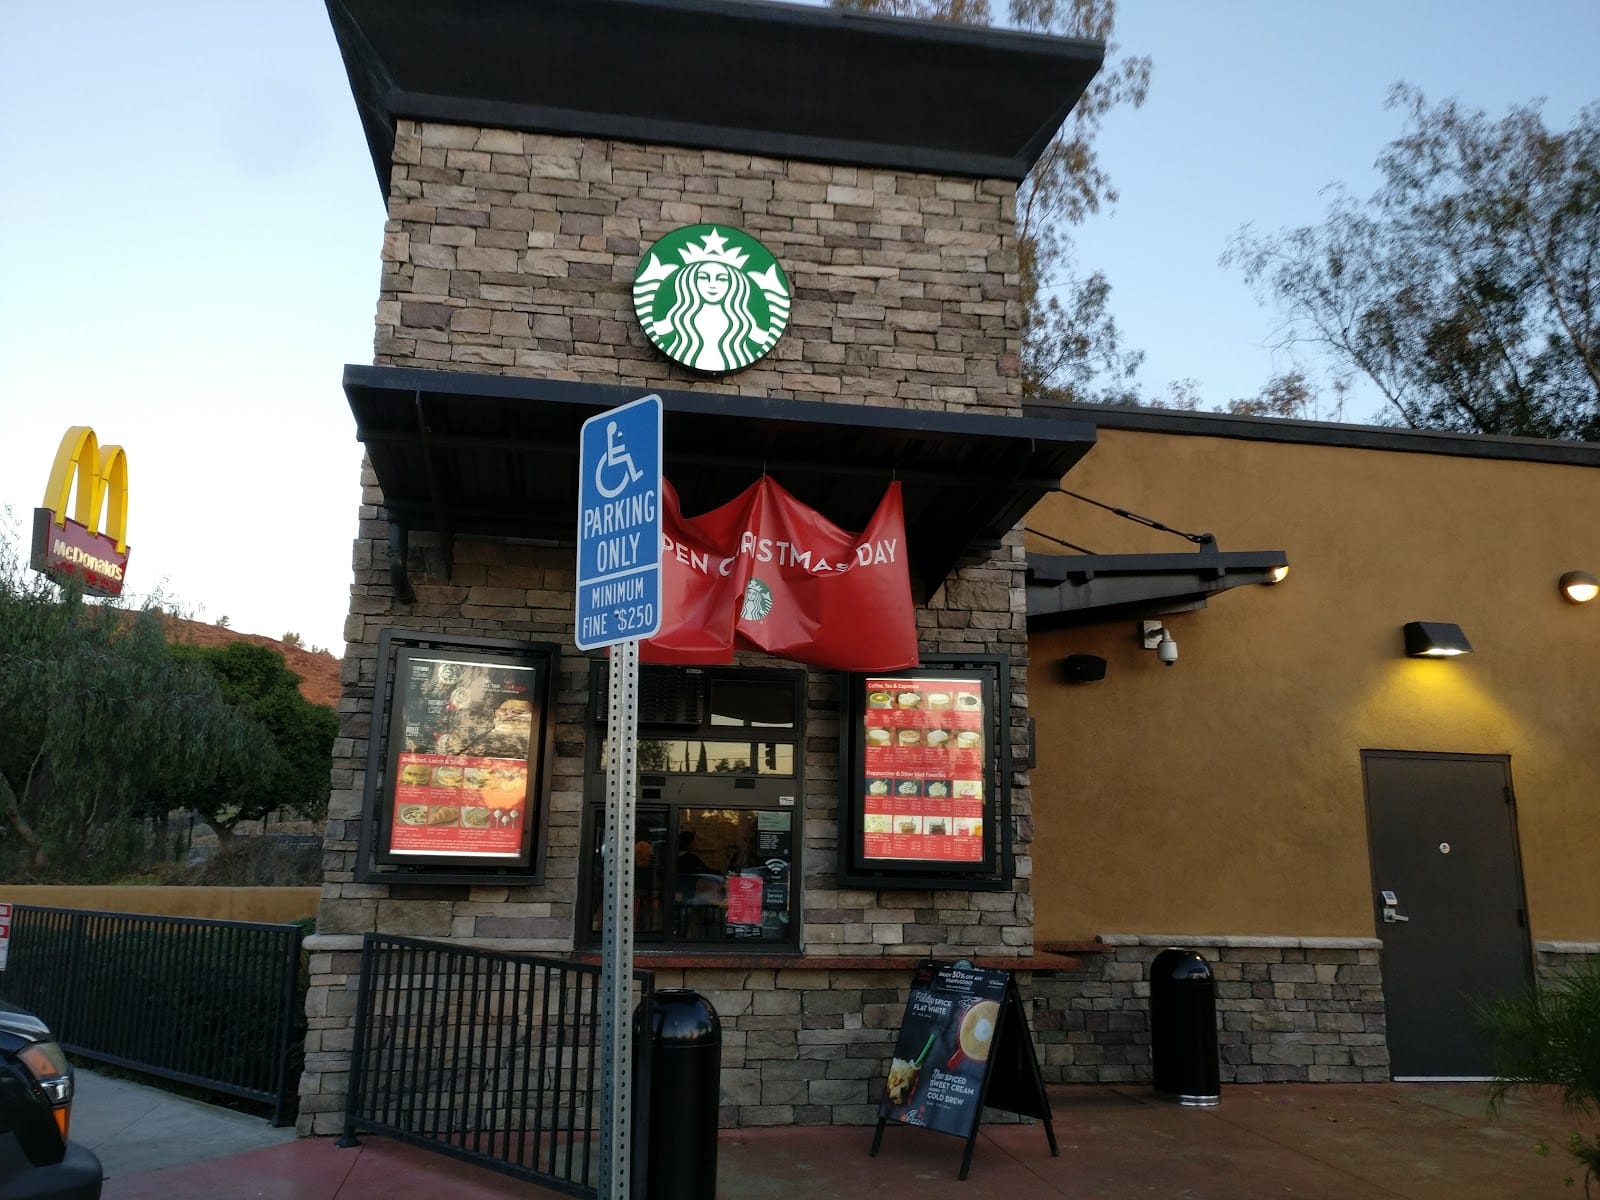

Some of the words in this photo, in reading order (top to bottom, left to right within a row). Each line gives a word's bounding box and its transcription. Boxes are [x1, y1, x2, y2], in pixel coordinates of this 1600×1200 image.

[583, 490, 655, 540] PARKING
[596, 532, 641, 573] ONLY
[661, 532, 709, 575] PEN
[855, 538, 897, 568] DAY
[591, 577, 644, 609] MINIMUM
[582, 613, 608, 639] FINE
[617, 603, 654, 633] $250
[951, 971, 965, 979] 50%
[913, 1003, 928, 1012] FLAT
[928, 1005, 948, 1015] WHITE
[934, 999, 952, 1008] SPICE
[929, 1079, 950, 1090] SWEET
[950, 1084, 975, 1096] CREAM
[944, 1073, 967, 1085] SPICED
[927, 1091, 945, 1101] COLD
[944, 1095, 965, 1106] BREW
